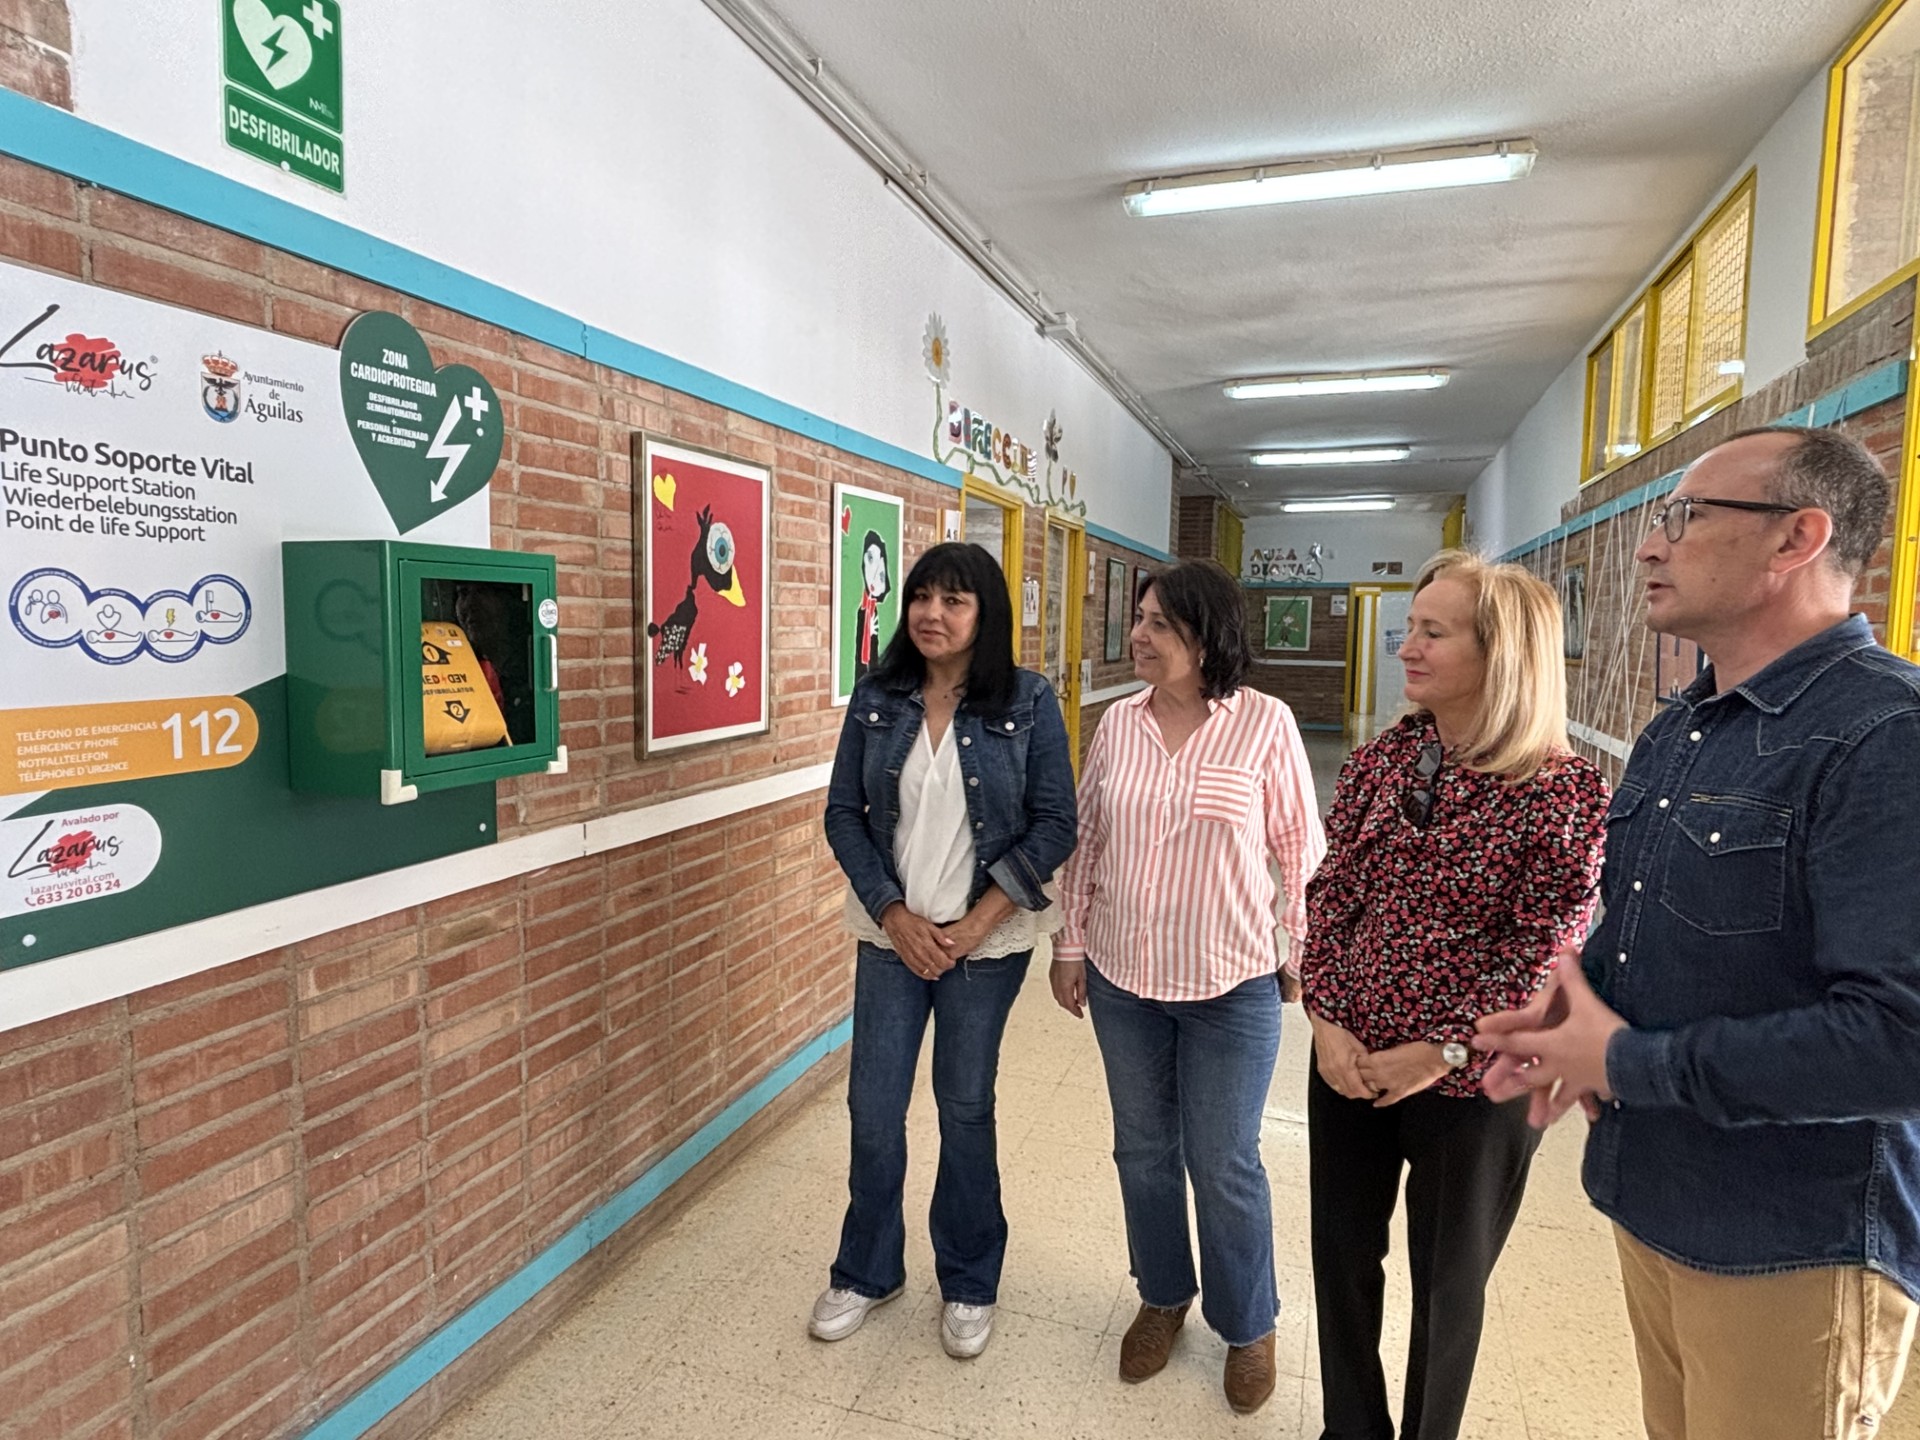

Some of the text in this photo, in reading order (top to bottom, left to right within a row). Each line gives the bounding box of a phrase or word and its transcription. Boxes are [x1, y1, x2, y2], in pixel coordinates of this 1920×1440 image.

[229, 104, 340, 176] DESFIBRILADOR
[382, 349, 408, 369] ZONA
[243, 371, 304, 392] Ayuntamiento
[350, 362, 437, 397] CARDIOPROTEGIDA
[269, 389, 280, 400] de
[369, 391, 418, 410] DESFIBRILADOR
[244, 394, 304, 423] Águilas
[357, 419, 429, 442] PERSONAL ENTRENADO
[371, 432, 416, 449] Y ACREDITADO
[0, 428, 254, 484] Punto Soporte Vital
[1, 461, 196, 500] Life Support Station
[3, 486, 237, 524] Wiederbelebungsstation
[6, 509, 206, 543] Point de life Support
[16, 722, 157, 742] TELÉFONO DE EMERGENCIAS
[162, 708, 242, 759] 112
[17, 737, 119, 756] EMERGENCY PHONE
[17, 752, 108, 769] NOTFALLTELEFON
[61, 811, 119, 827] Avalado por
[8, 820, 123, 878] Lazarus
[30, 872, 114, 895] lazarusvital.com
[36, 879, 121, 905] 633 20 03 24
